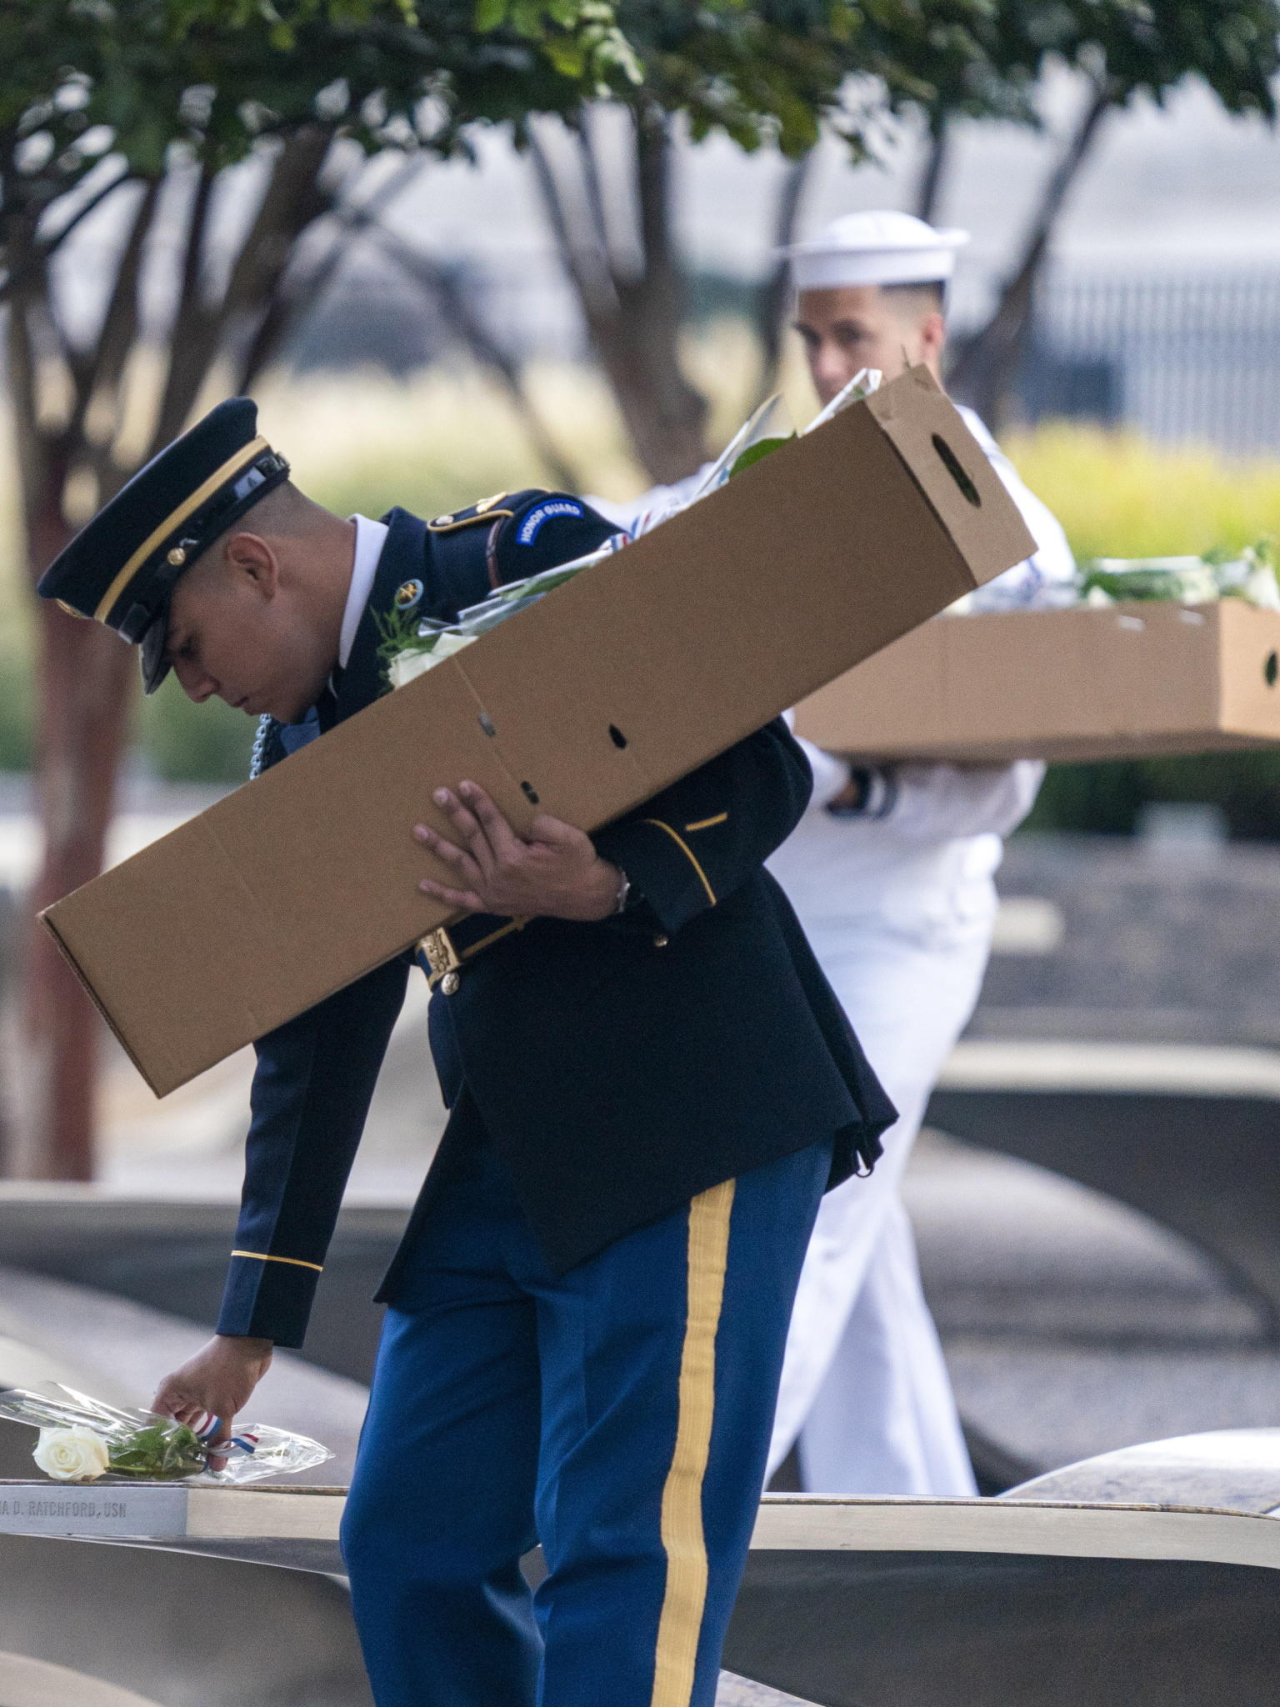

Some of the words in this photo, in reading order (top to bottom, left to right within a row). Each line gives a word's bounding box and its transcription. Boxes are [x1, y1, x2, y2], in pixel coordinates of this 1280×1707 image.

[520, 509, 546, 543] HONOR
[543, 502, 581, 516] GUARD
[13, 1500, 25, 1516] D.
[28, 1501, 102, 1519] RATCHFORD,
[103, 1502, 127, 1518] USN
